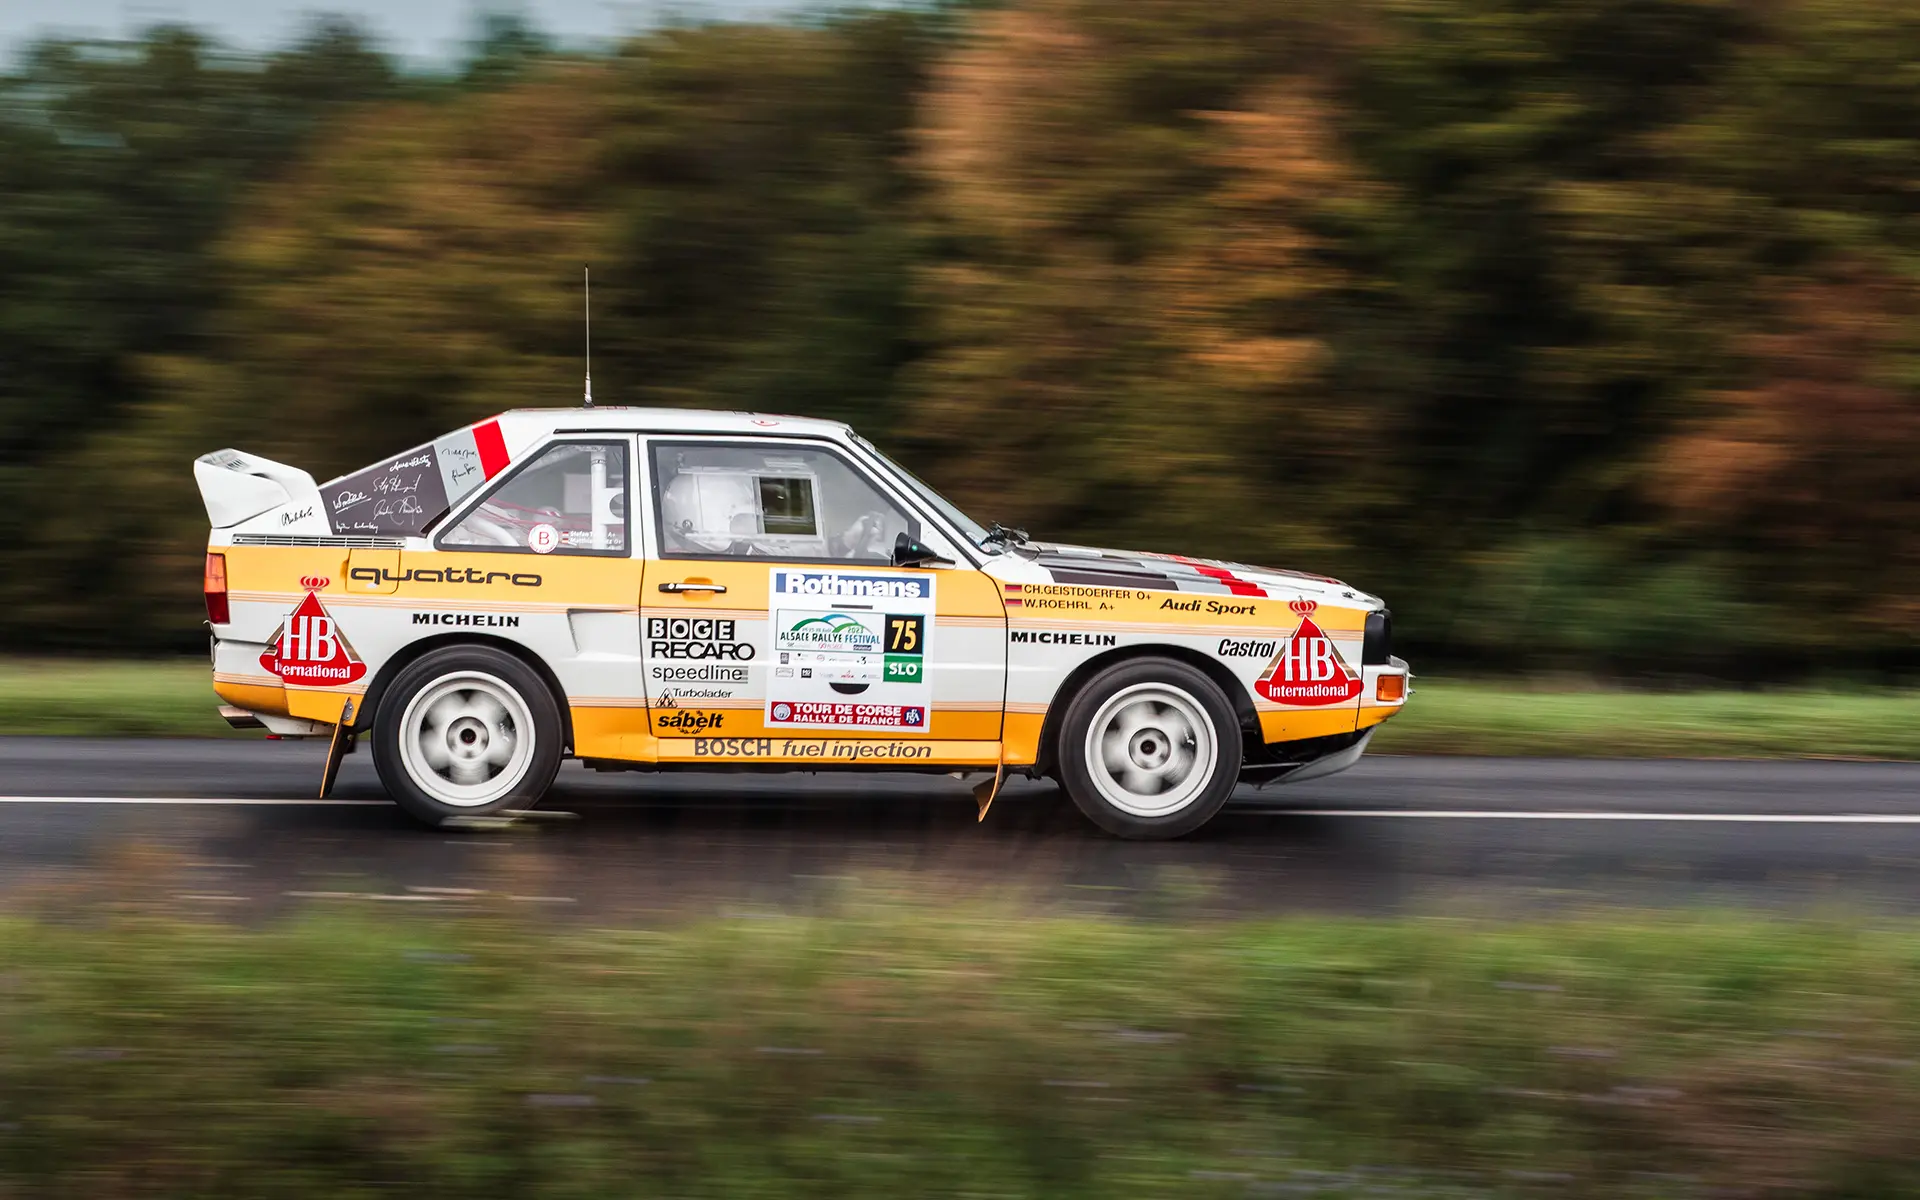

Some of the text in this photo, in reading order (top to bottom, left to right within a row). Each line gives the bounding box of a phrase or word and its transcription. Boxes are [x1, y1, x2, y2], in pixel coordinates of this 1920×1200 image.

[539, 532, 549, 545] B
[350, 567, 542, 587] quattro
[785, 573, 921, 597] Rothmans
[1024, 584, 1131, 599] CH.GEISTDOERFER
[1024, 599, 1116, 610] W.ROEHRL A+
[1159, 599, 1257, 616] Audi Sport
[412, 613, 520, 627] MICHELIN
[648, 618, 735, 640] BOGE
[891, 620, 917, 651] 75
[283, 615, 336, 662] HB
[780, 632, 880, 644] ALSACE RALLYE FESTIVAL
[1011, 631, 1116, 646] MICHELIN
[651, 641, 755, 661] RECARO
[1218, 638, 1276, 658] Castrol
[1284, 637, 1335, 681] HB
[652, 665, 743, 682] speedline
[889, 662, 917, 676] SLO
[673, 688, 733, 699] Turbolader
[793, 703, 902, 717] TOUR DE CORSE
[658, 711, 724, 728] sabelt
[793, 714, 902, 726] RALLYE DE FRANCE
[694, 739, 932, 760] BOSCH fuel injection
